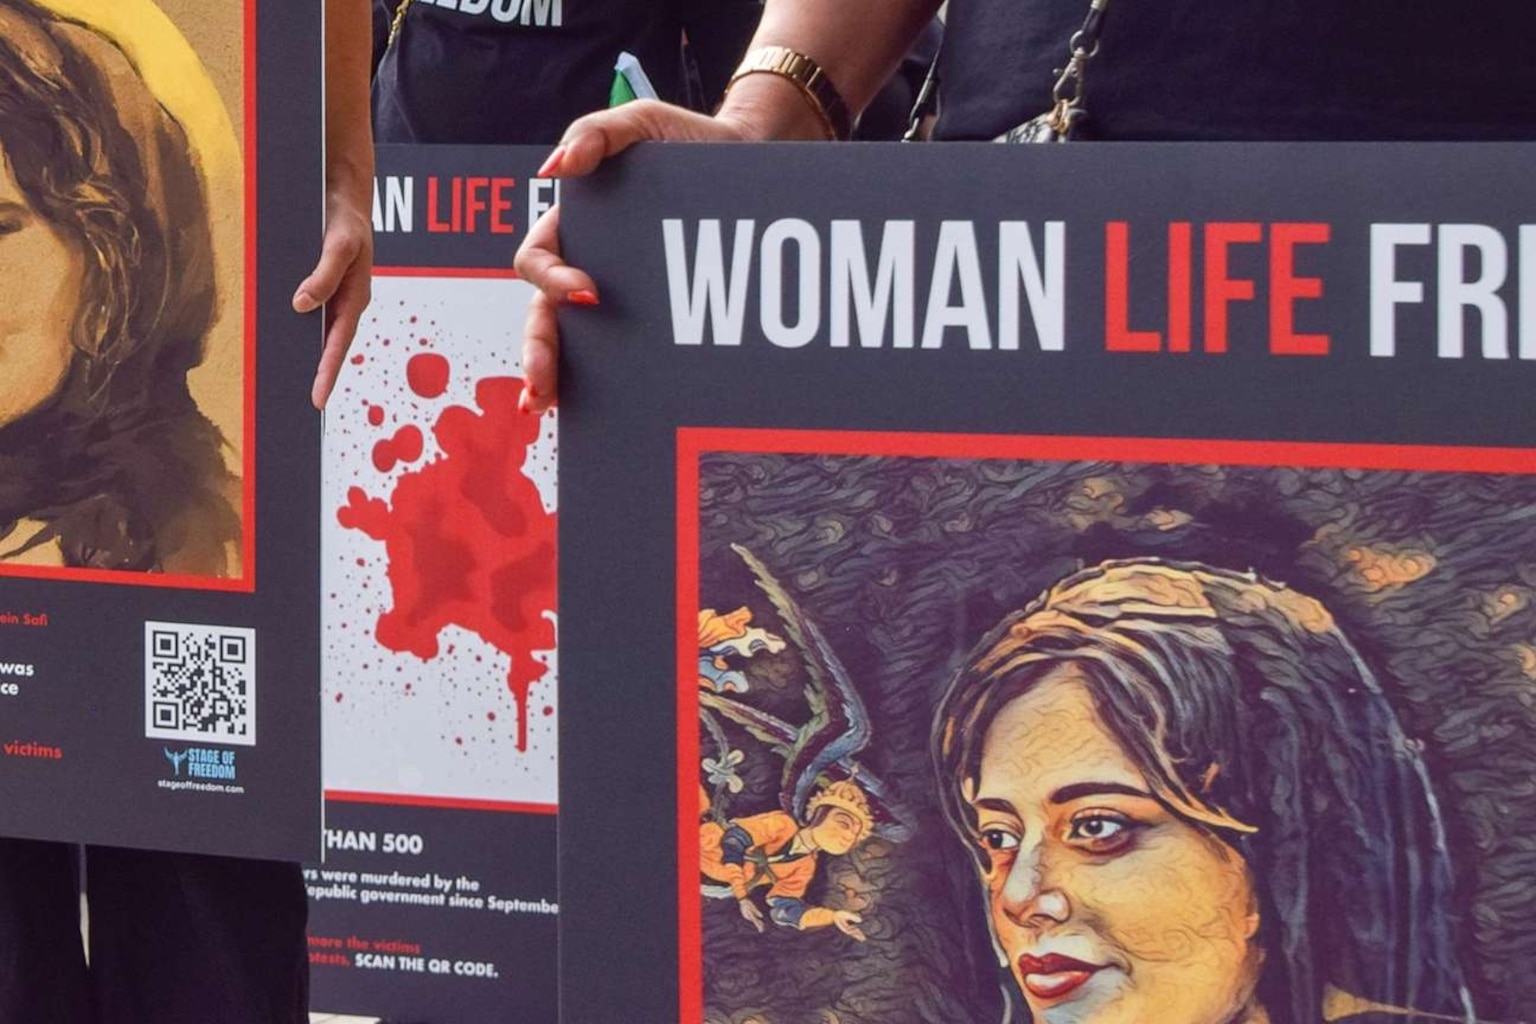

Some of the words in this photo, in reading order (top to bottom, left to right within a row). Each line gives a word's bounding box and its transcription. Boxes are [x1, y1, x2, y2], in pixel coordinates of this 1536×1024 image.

[427, 177, 514, 233] LIFE
[663, 218, 1065, 351] WOMAN
[1105, 222, 1331, 355] LIFE
[4, 740, 62, 760] victims
[188, 748, 219, 763] STAGE
[223, 751, 235, 764] OF
[188, 763, 236, 779] FREEDOM
[324, 829, 376, 851] HAN
[382, 833, 423, 854] 500
[321, 870, 357, 882] were
[360, 871, 430, 889] murdered
[434, 874, 452, 893] by
[456, 875, 480, 892] the
[305, 883, 357, 901] epublic
[360, 888, 445, 905] government
[448, 893, 484, 909] since
[355, 953, 395, 969] SCAN
[398, 956, 425, 972] THE
[428, 959, 451, 974] QR
[454, 961, 499, 978] CODE.
